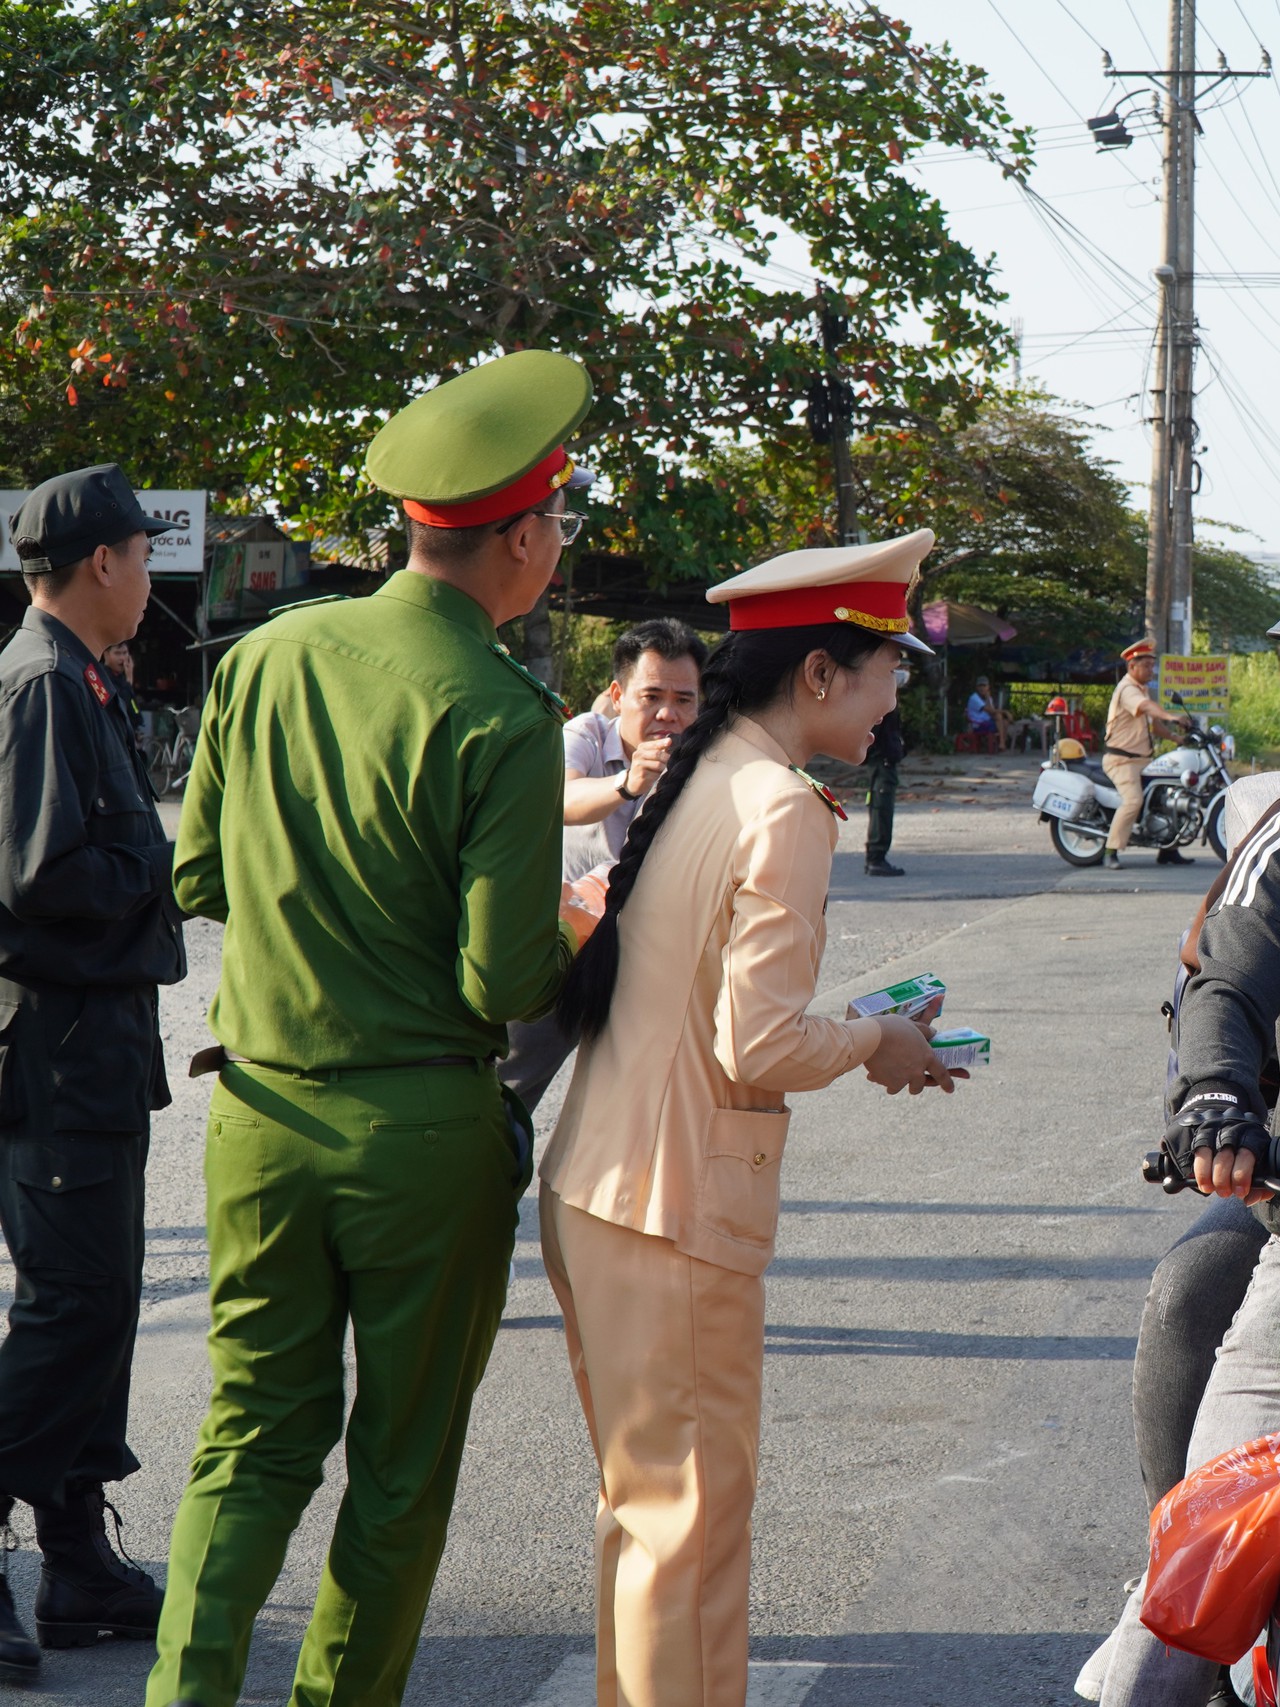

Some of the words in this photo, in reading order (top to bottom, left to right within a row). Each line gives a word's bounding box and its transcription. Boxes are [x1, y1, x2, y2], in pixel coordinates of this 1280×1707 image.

[142, 509, 190, 531] NG
[149, 536, 173, 546] ƯỚC
[1052, 799, 1073, 812] CSGT
